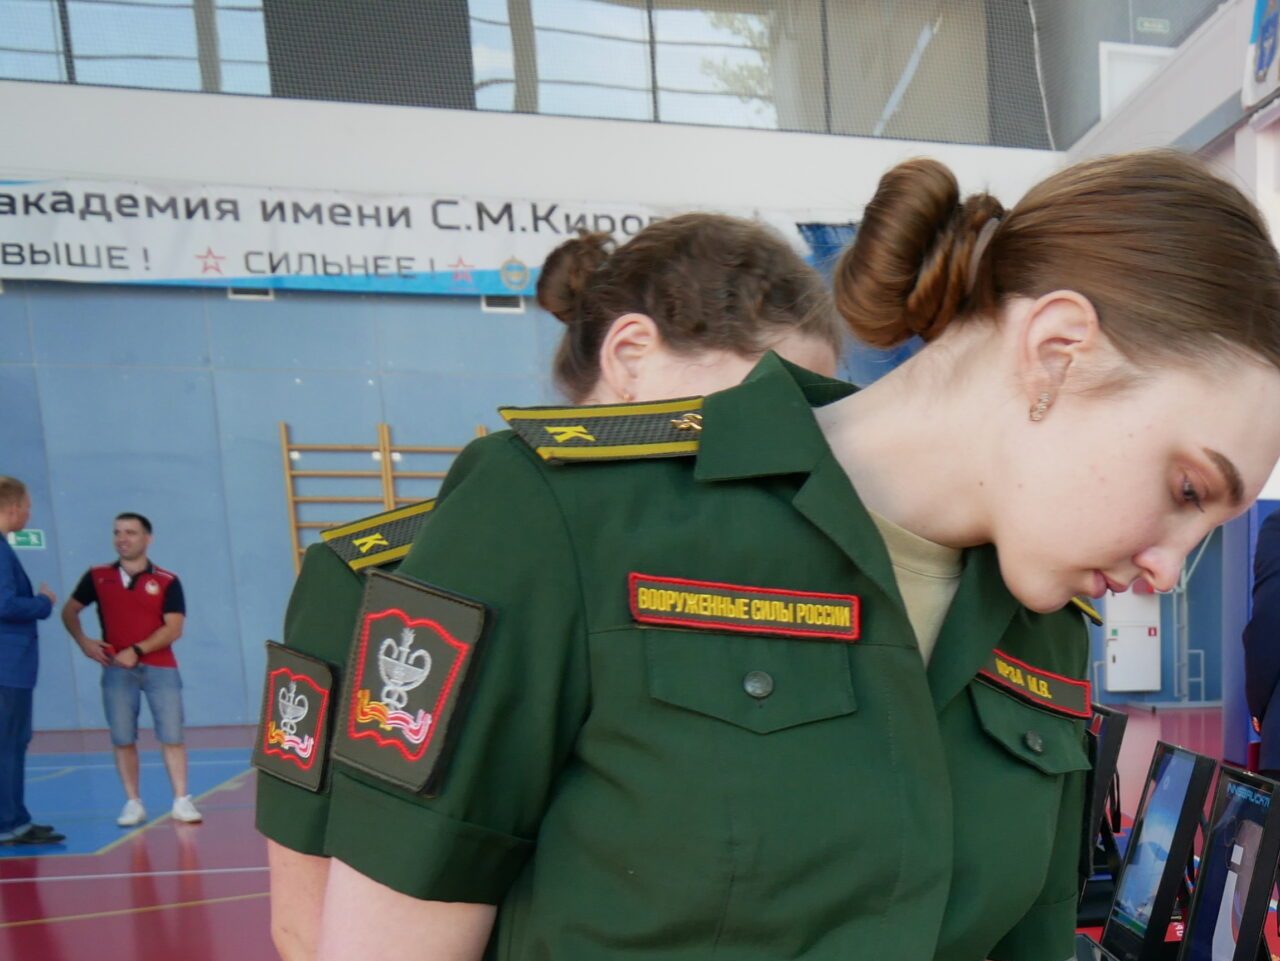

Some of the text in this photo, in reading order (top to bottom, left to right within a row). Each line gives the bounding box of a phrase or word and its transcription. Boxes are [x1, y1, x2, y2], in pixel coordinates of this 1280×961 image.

[0, 190, 666, 236] академия имени С.М.Киро
[637, 587, 851, 627] ВООРУЖЕННЫЕ СИЛЫ РОССИИ
